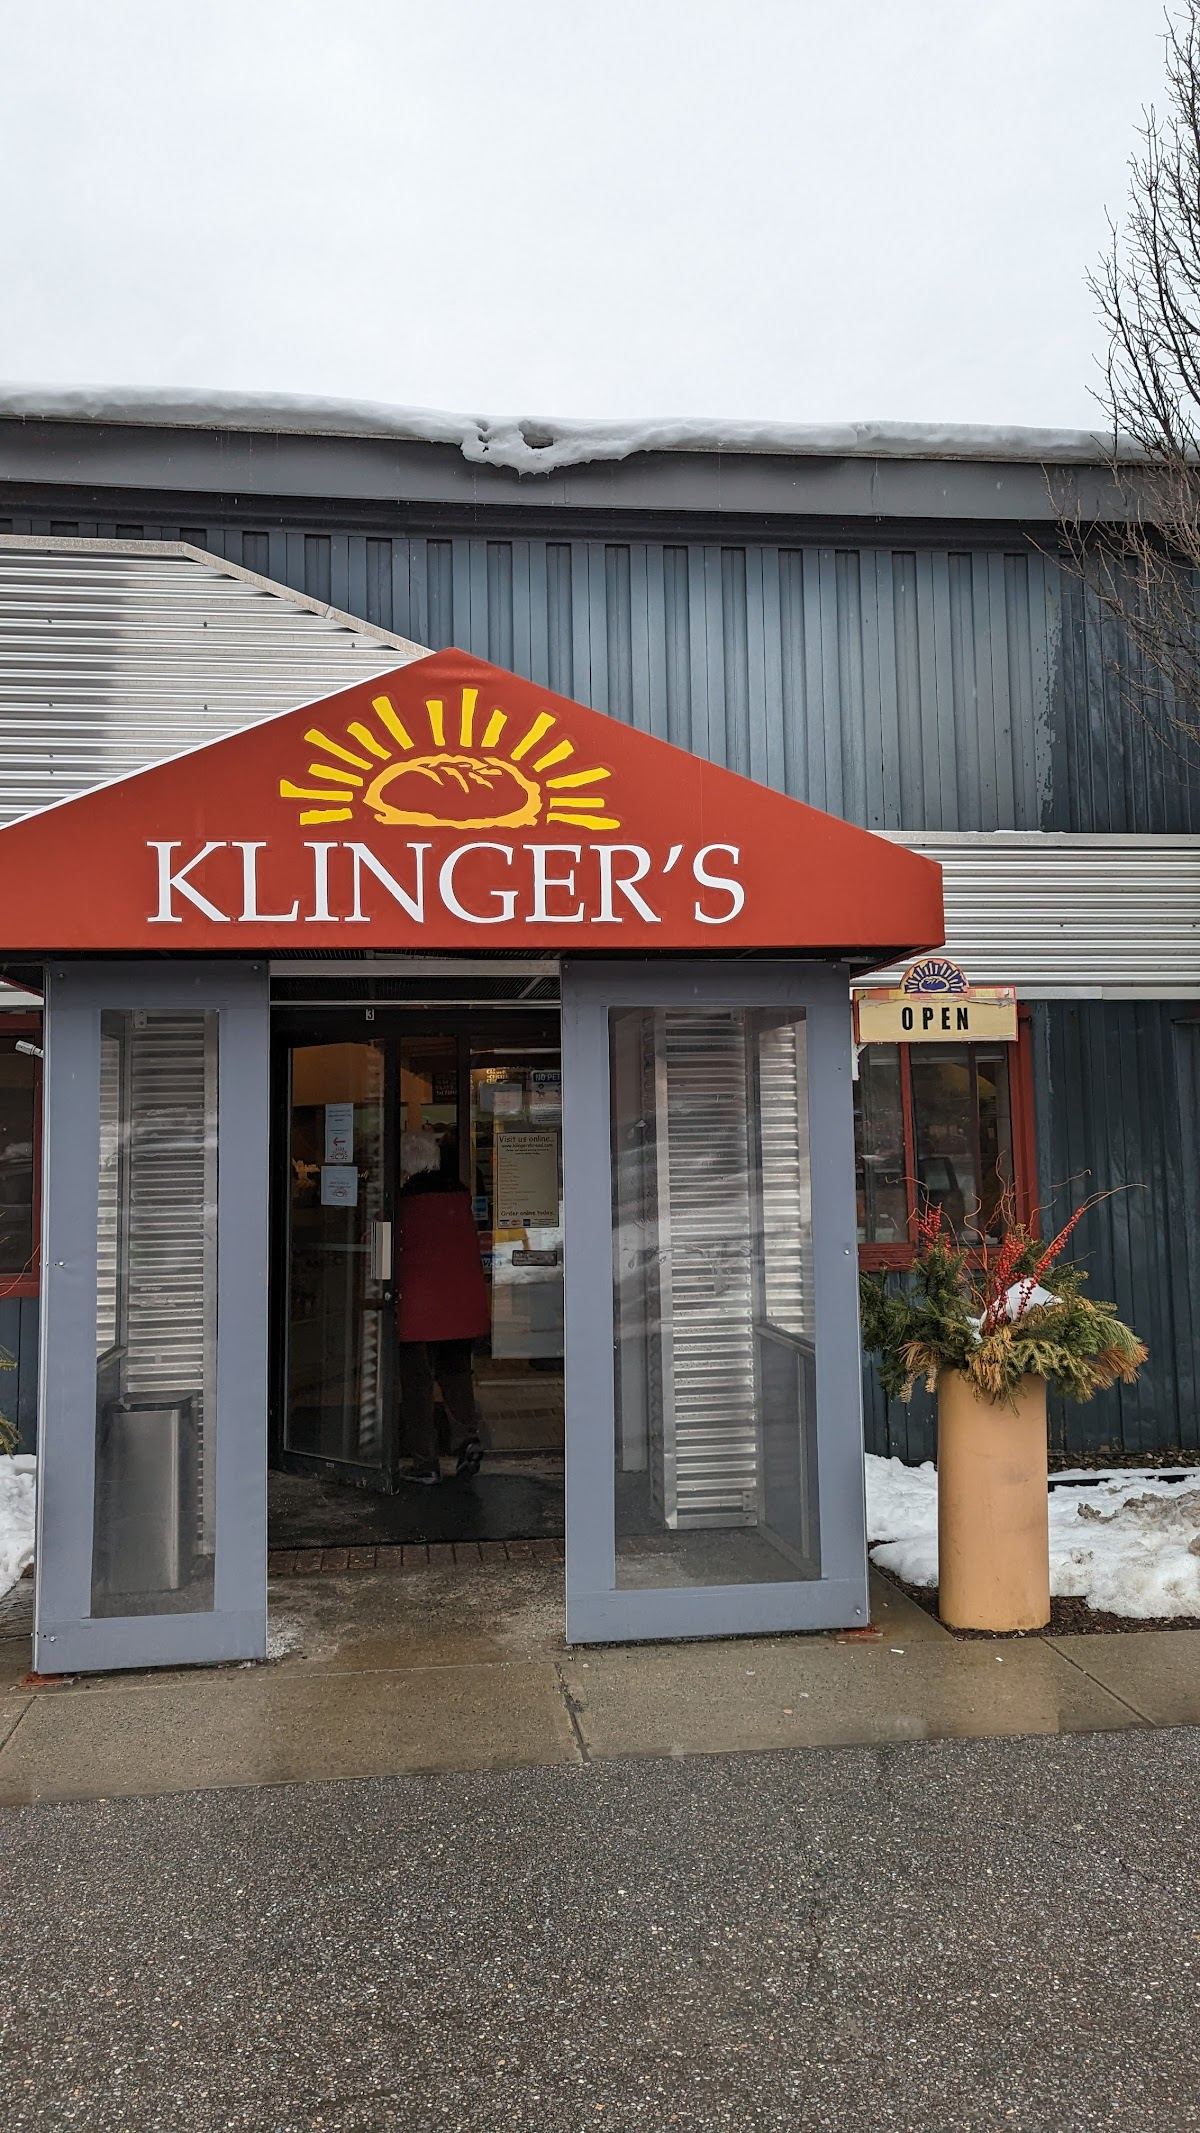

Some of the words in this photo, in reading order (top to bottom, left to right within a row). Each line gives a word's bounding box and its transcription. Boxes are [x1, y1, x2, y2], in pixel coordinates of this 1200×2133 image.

[147, 841, 746, 925] KLINGER'S
[366, 1008, 374, 1020] 3
[901, 1006, 969, 1031] OPEN
[535, 1073, 546, 1082] NO
[499, 1135, 516, 1143] Visit
[500, 1209, 518, 1217] Order
